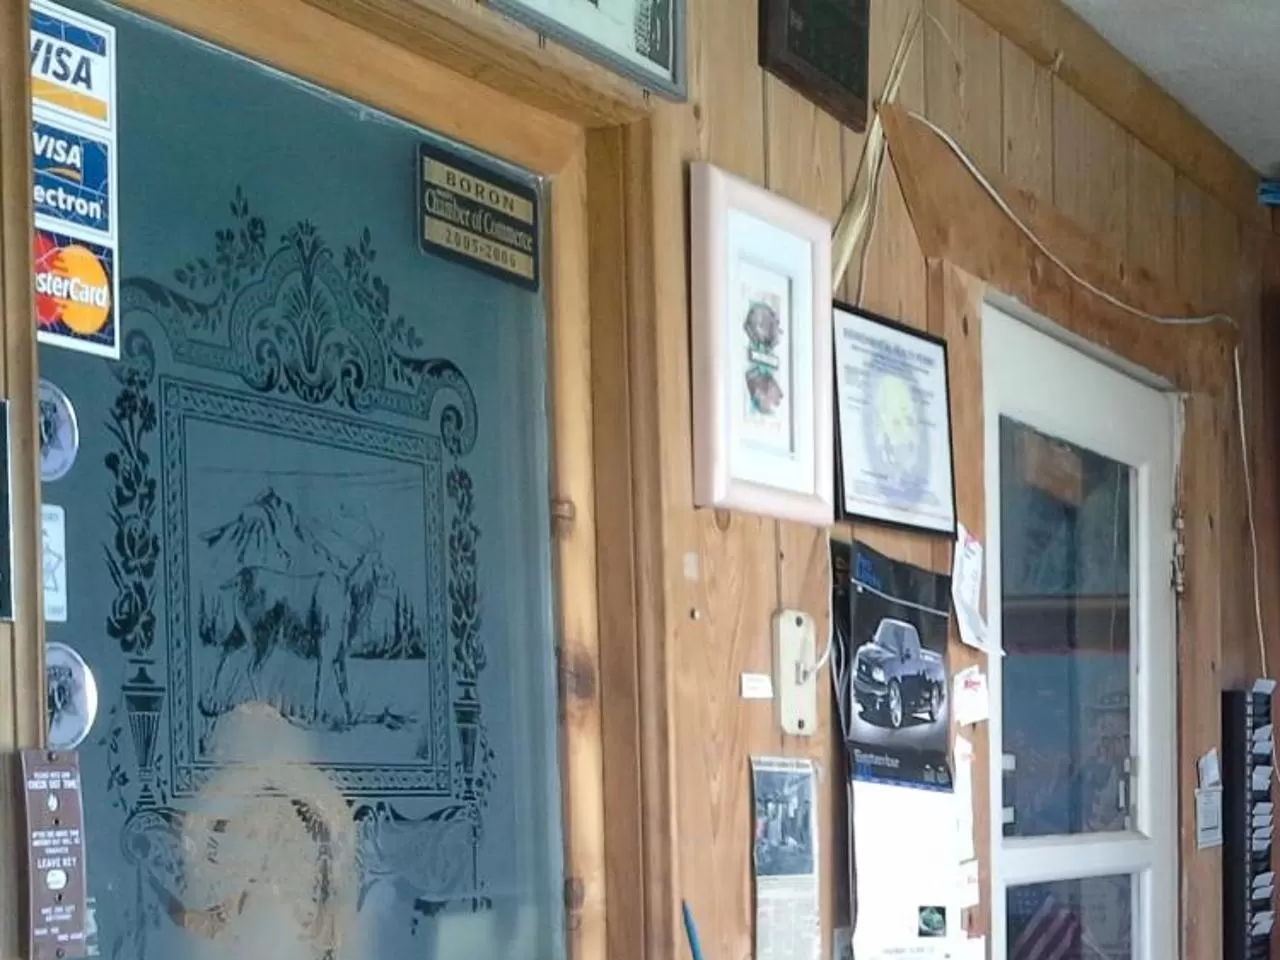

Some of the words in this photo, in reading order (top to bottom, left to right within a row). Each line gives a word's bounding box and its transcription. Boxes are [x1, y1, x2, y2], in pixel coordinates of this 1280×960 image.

[32, 132, 81, 168] VISA
[33, 185, 102, 218] ectron
[425, 188, 470, 228] Chamber
[445, 170, 515, 212] BORON
[35, 271, 107, 309] sterCard
[37, 857, 61, 869] LEAVE
